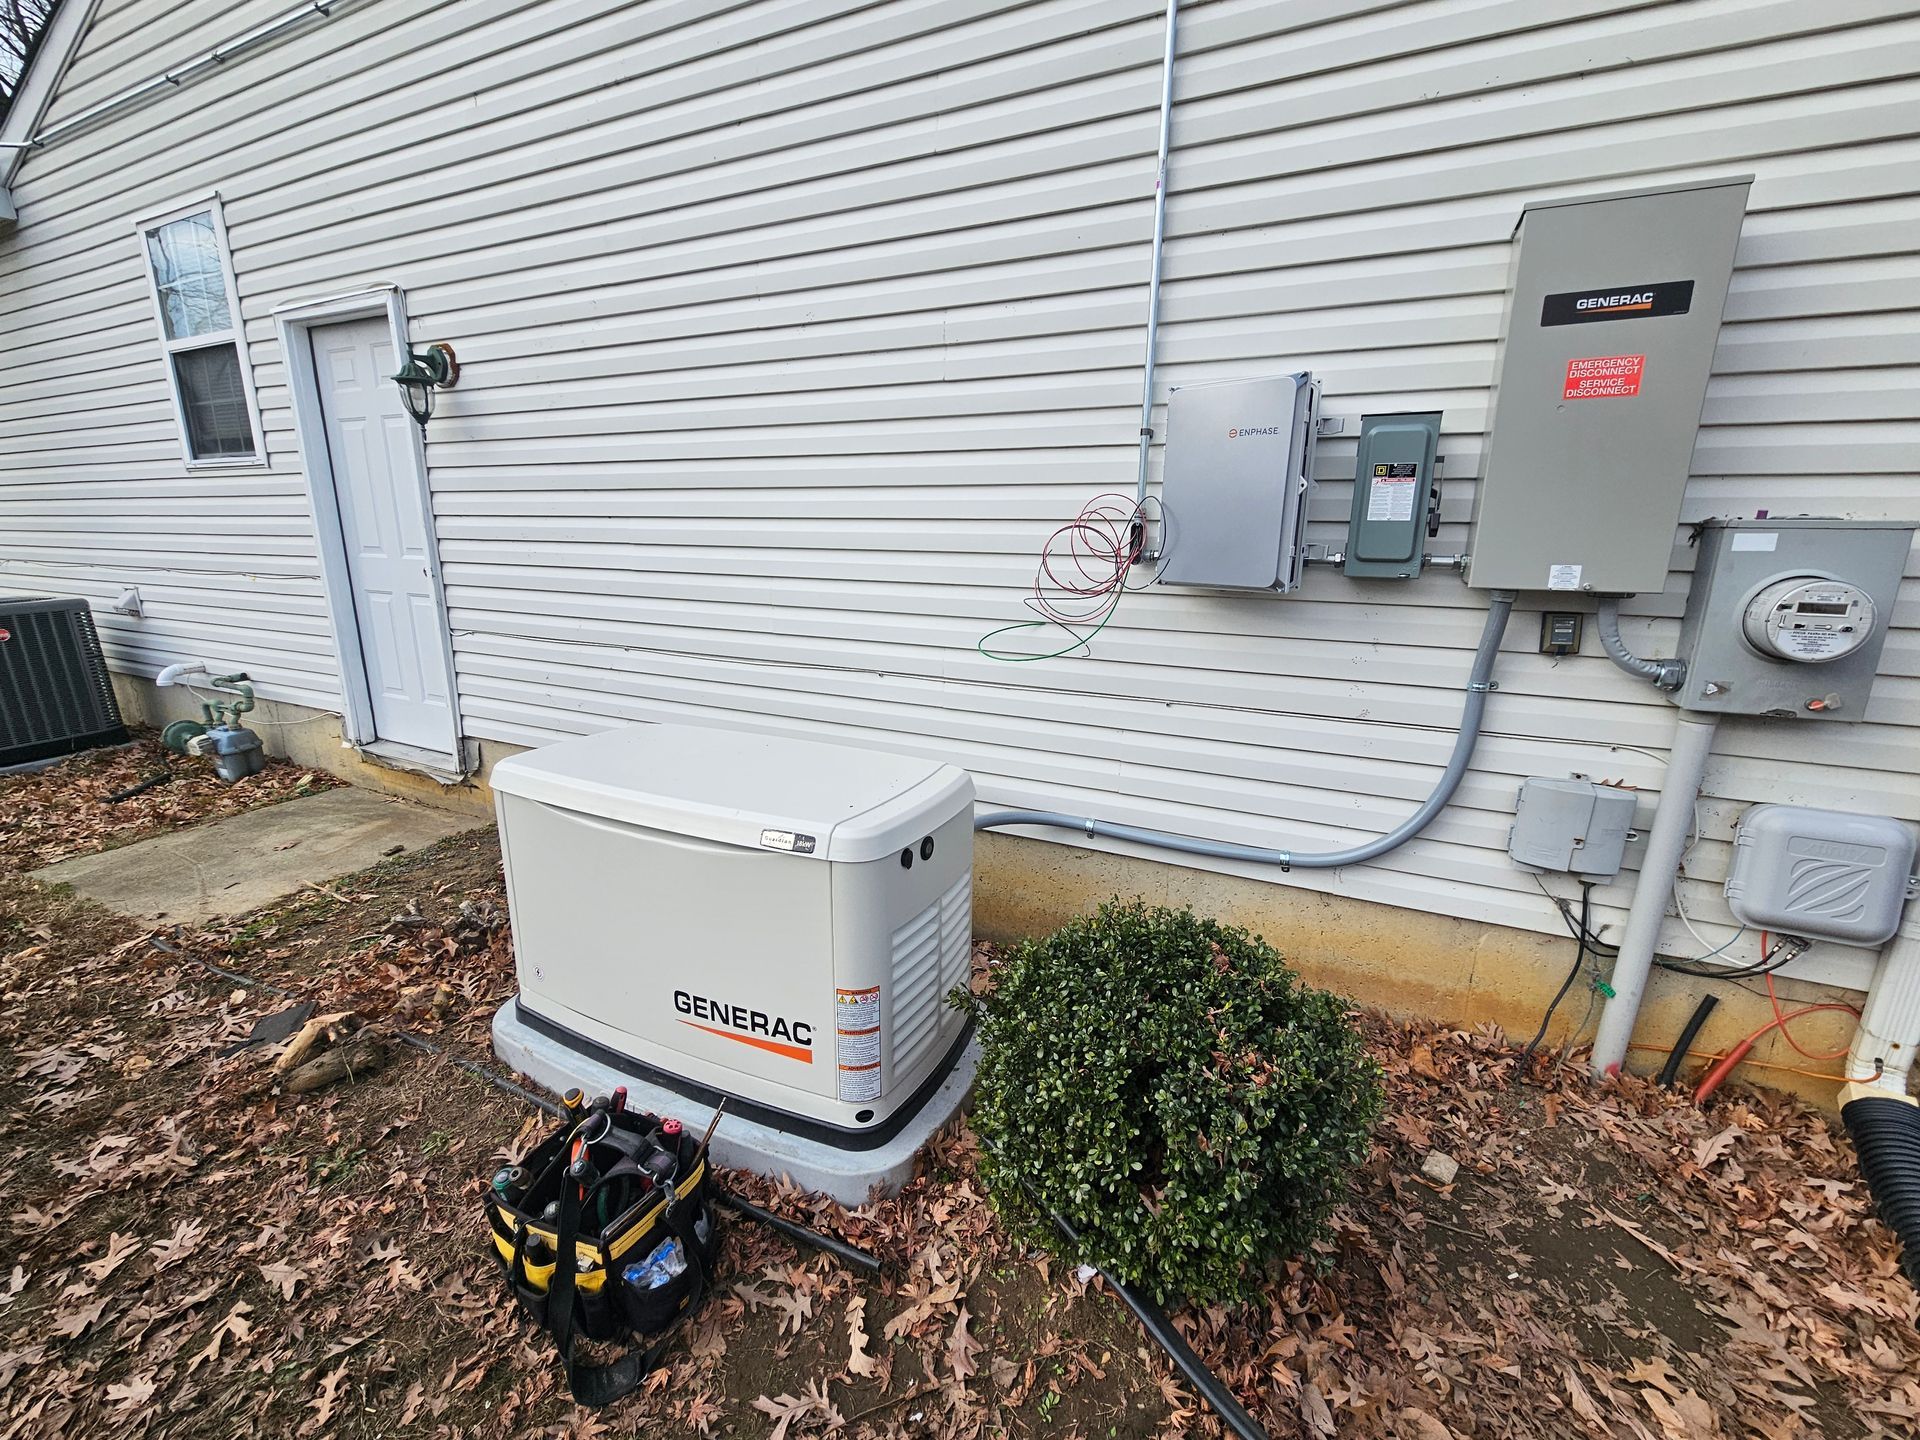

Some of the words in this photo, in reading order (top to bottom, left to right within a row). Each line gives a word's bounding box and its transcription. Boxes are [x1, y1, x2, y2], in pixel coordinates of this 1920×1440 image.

[1576, 293, 1653, 309] GENERAC
[1571, 357, 1641, 370] EMERGENCY
[1569, 366, 1640, 378] DISCONNECT
[1579, 378, 1625, 388] SERVICE
[1566, 385, 1636, 398] DISCONNECT
[1239, 427, 1279, 437] ENPHASE
[674, 990, 812, 1045] GENERAC
